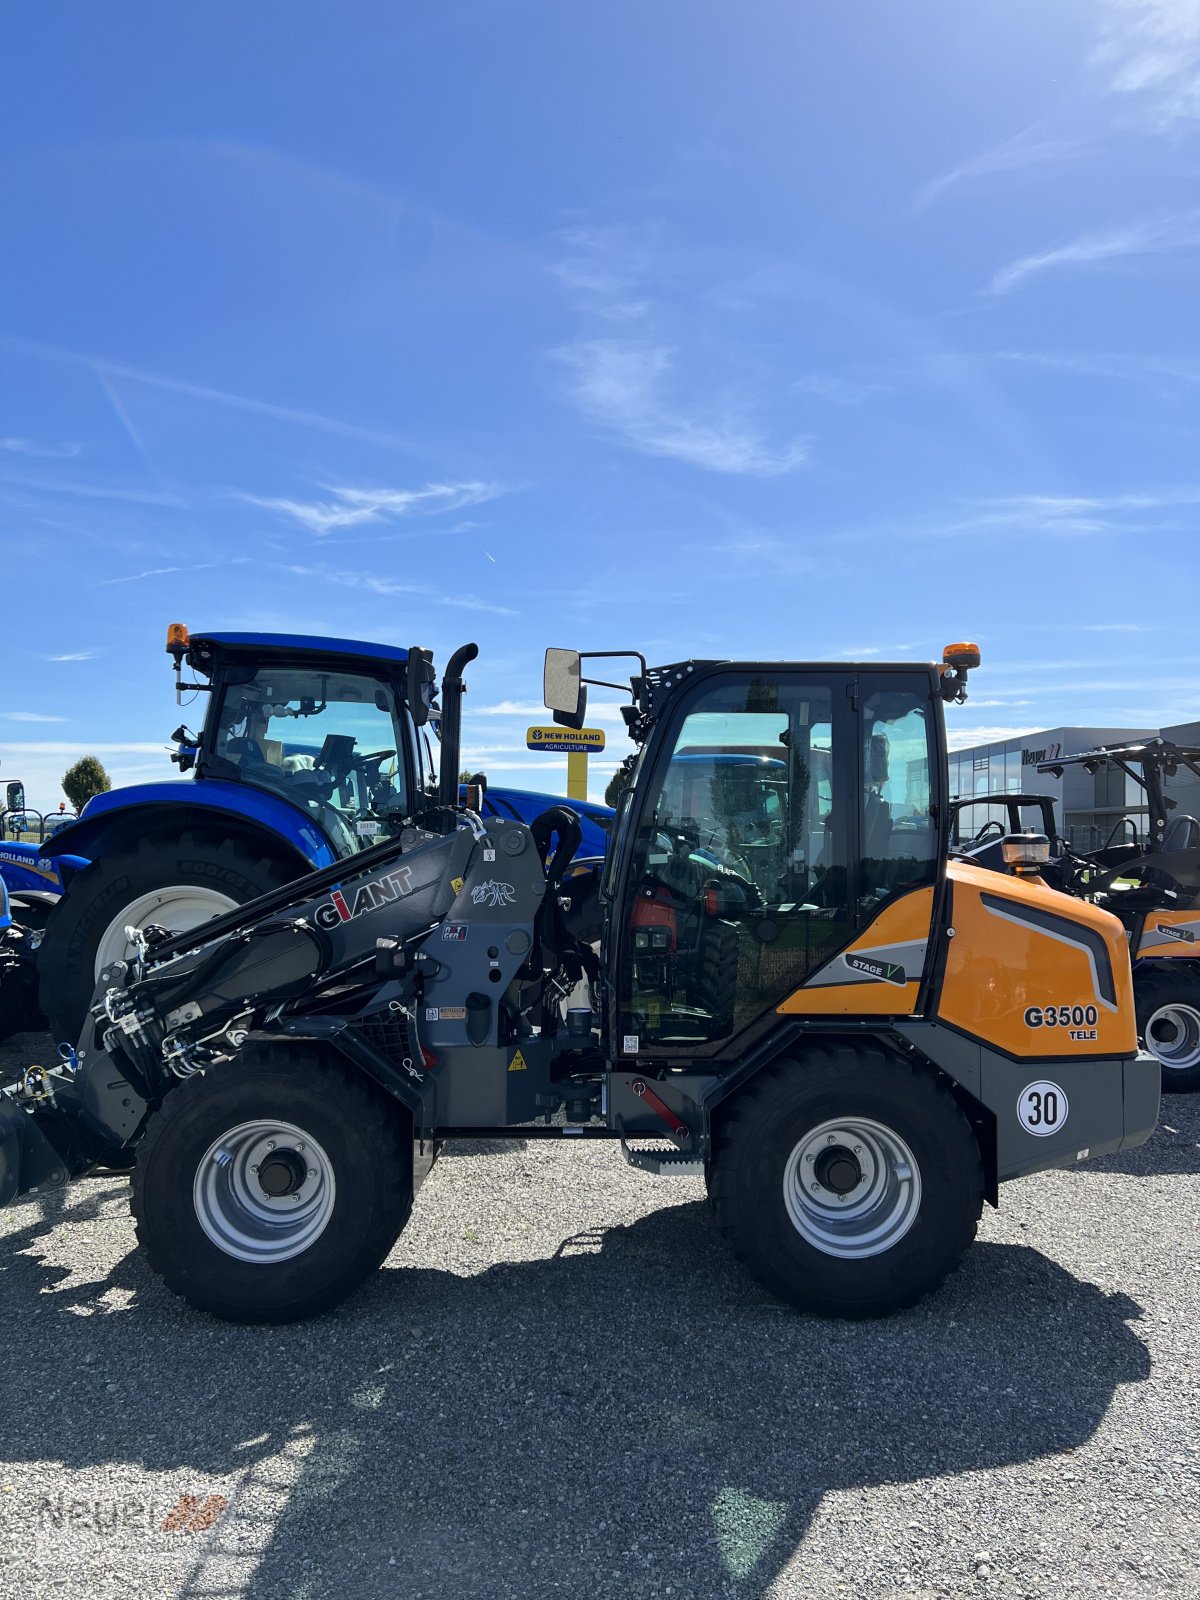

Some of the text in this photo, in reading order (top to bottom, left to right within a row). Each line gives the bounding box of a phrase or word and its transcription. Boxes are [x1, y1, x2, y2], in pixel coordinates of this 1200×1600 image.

[1161, 927, 1181, 938] STAGE
[852, 959, 901, 978] STAGE V
[1024, 1005, 1098, 1028] G3500
[1069, 1030, 1097, 1041] TELE
[1028, 1091, 1058, 1126] 30
